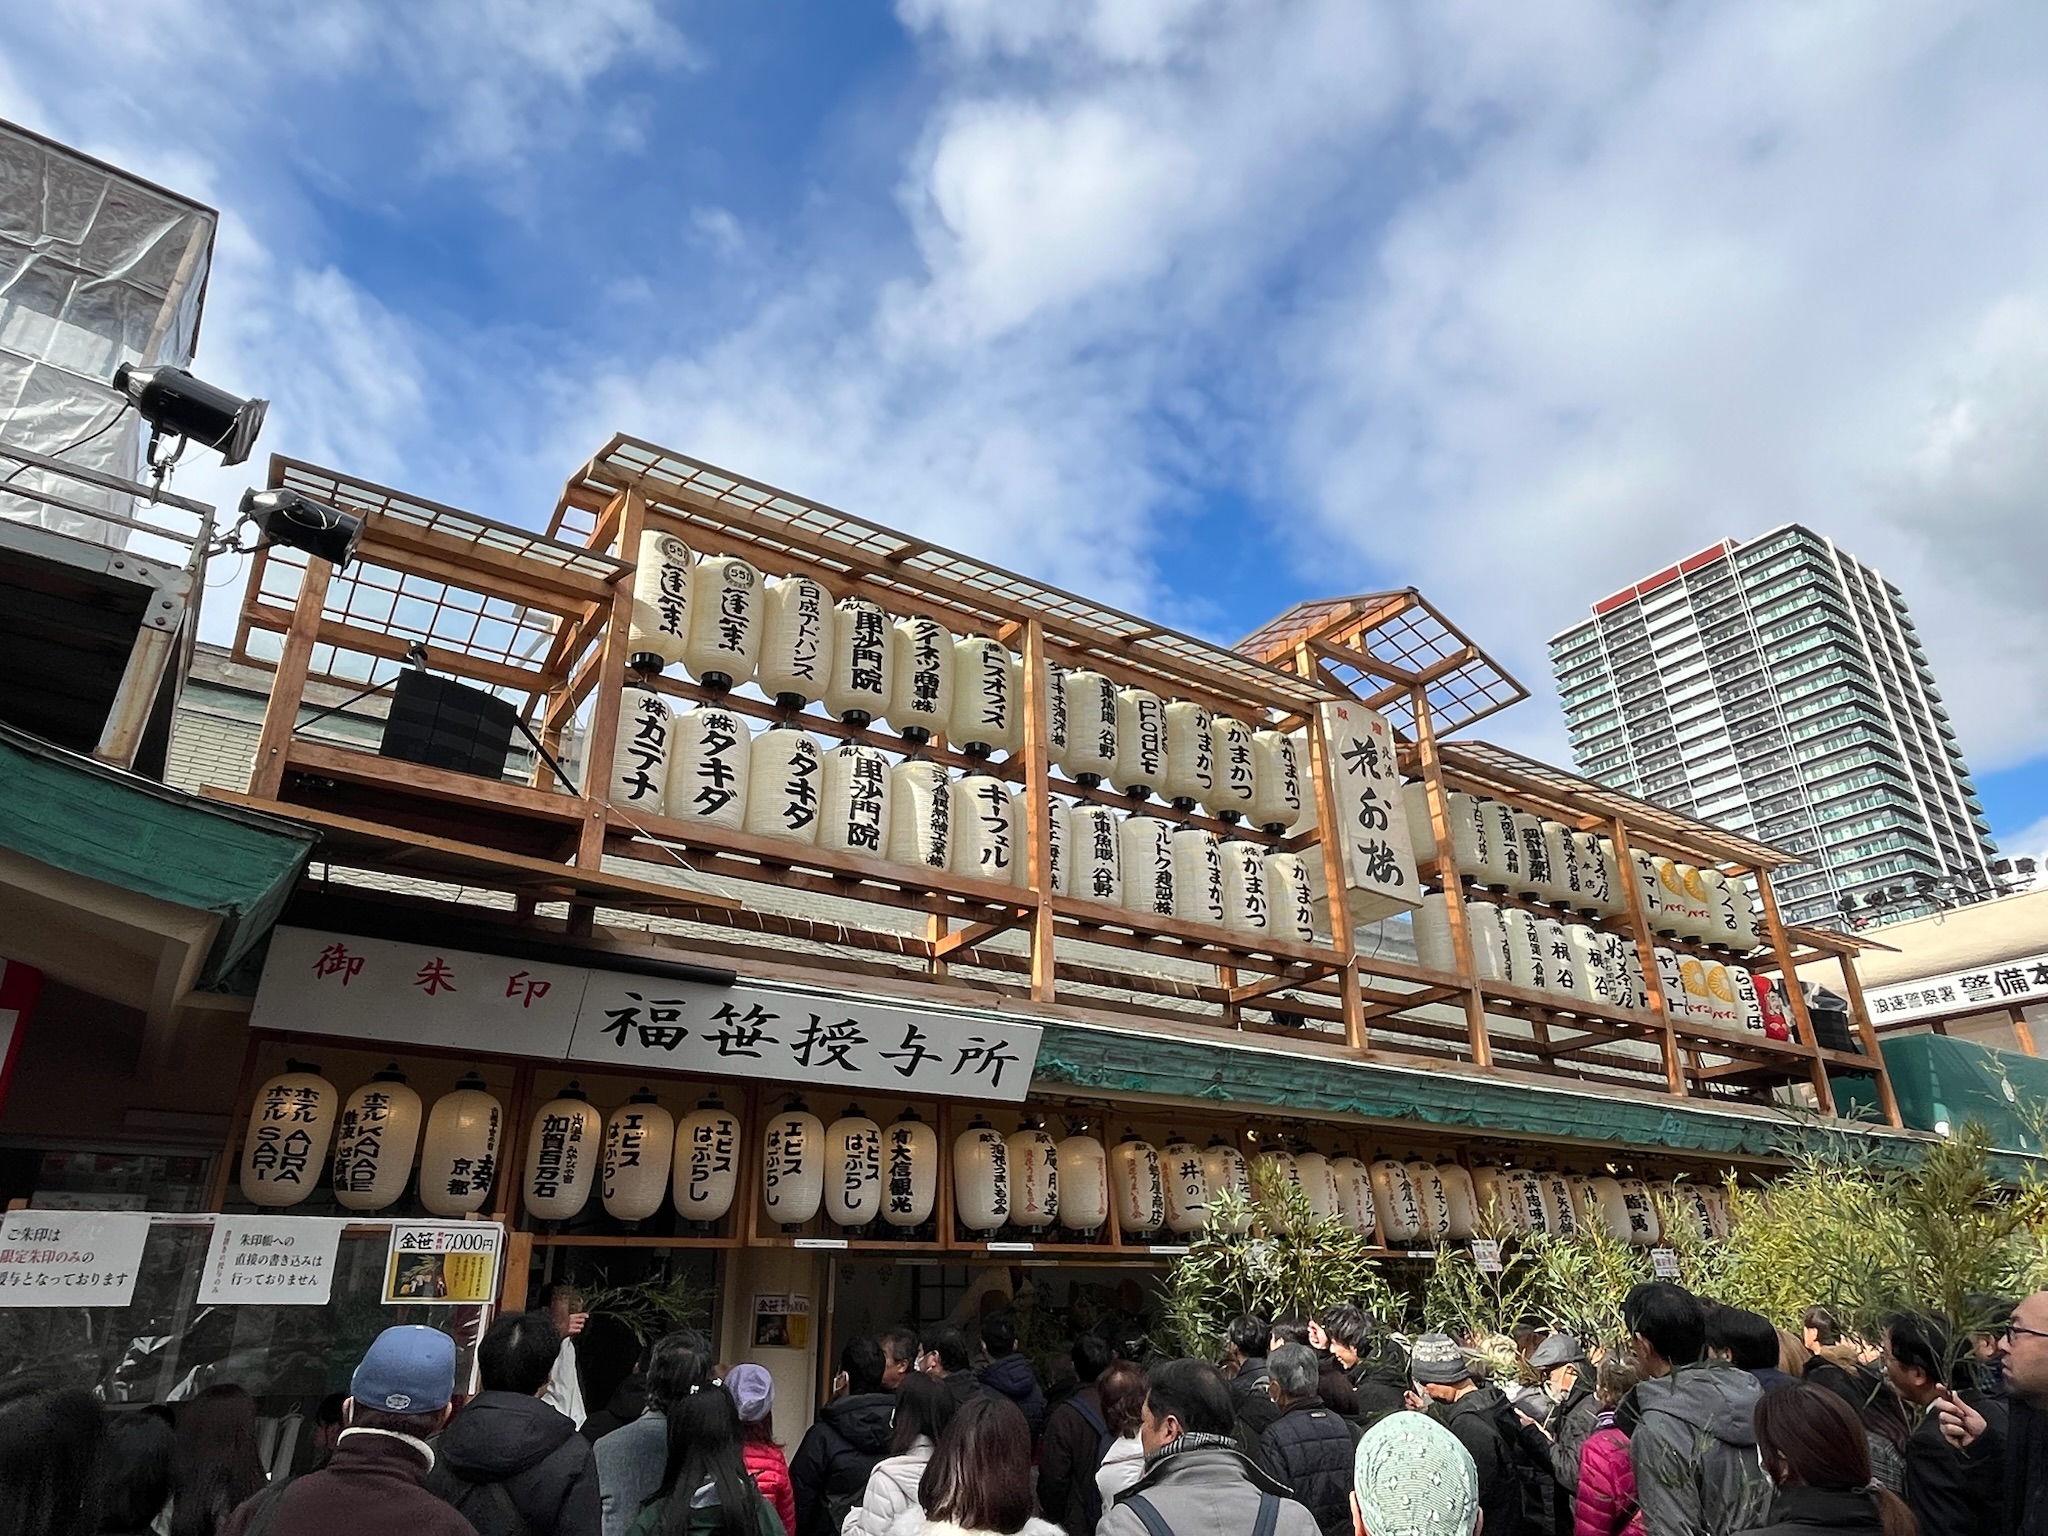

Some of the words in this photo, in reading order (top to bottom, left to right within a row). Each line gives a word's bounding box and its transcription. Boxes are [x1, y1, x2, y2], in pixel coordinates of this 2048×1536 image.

[670, 544, 689, 559] 551
[730, 568, 750, 581] 551
[847, 757, 884, 850] 毘沙門院
[977, 784, 1009, 868] キーフェル
[1637, 856, 1660, 909] ヤマト
[312, 942, 551, 1008] 御朱印
[1656, 956, 1686, 1013] ヤマト
[1873, 985, 1956, 1014] 浪速警察署
[600, 991, 1020, 1089] 福笹授与所
[262, 1085, 294, 1122] ホテル
[291, 1087, 320, 1124] ホテル
[361, 1092, 390, 1122] ホテル
[252, 1126, 281, 1181] SARI
[273, 1129, 312, 1184] AURA
[350, 1126, 384, 1192] KANADE
[532, 1114, 571, 1198] 加賀百万石
[618, 1114, 645, 1168] エビス
[689, 1126, 714, 1202] はぶらし
[712, 1120, 734, 1172] エビス
[782, 1122, 804, 1176] エビス
[864, 1128, 880, 1181] エビス
[446, 1158, 474, 1195] 京都
[766, 1130, 782, 1206] はぶらし
[844, 1133, 865, 1210] はぶらし
[8, 1228, 60, 1242] ご朱印は
[234, 1254, 322, 1268] 直接の書き込みは
[240, 1233, 295, 1248] 朱印帳への
[400, 1232, 434, 1250] 金笹
[230, 1272, 319, 1287] 行っておりません
